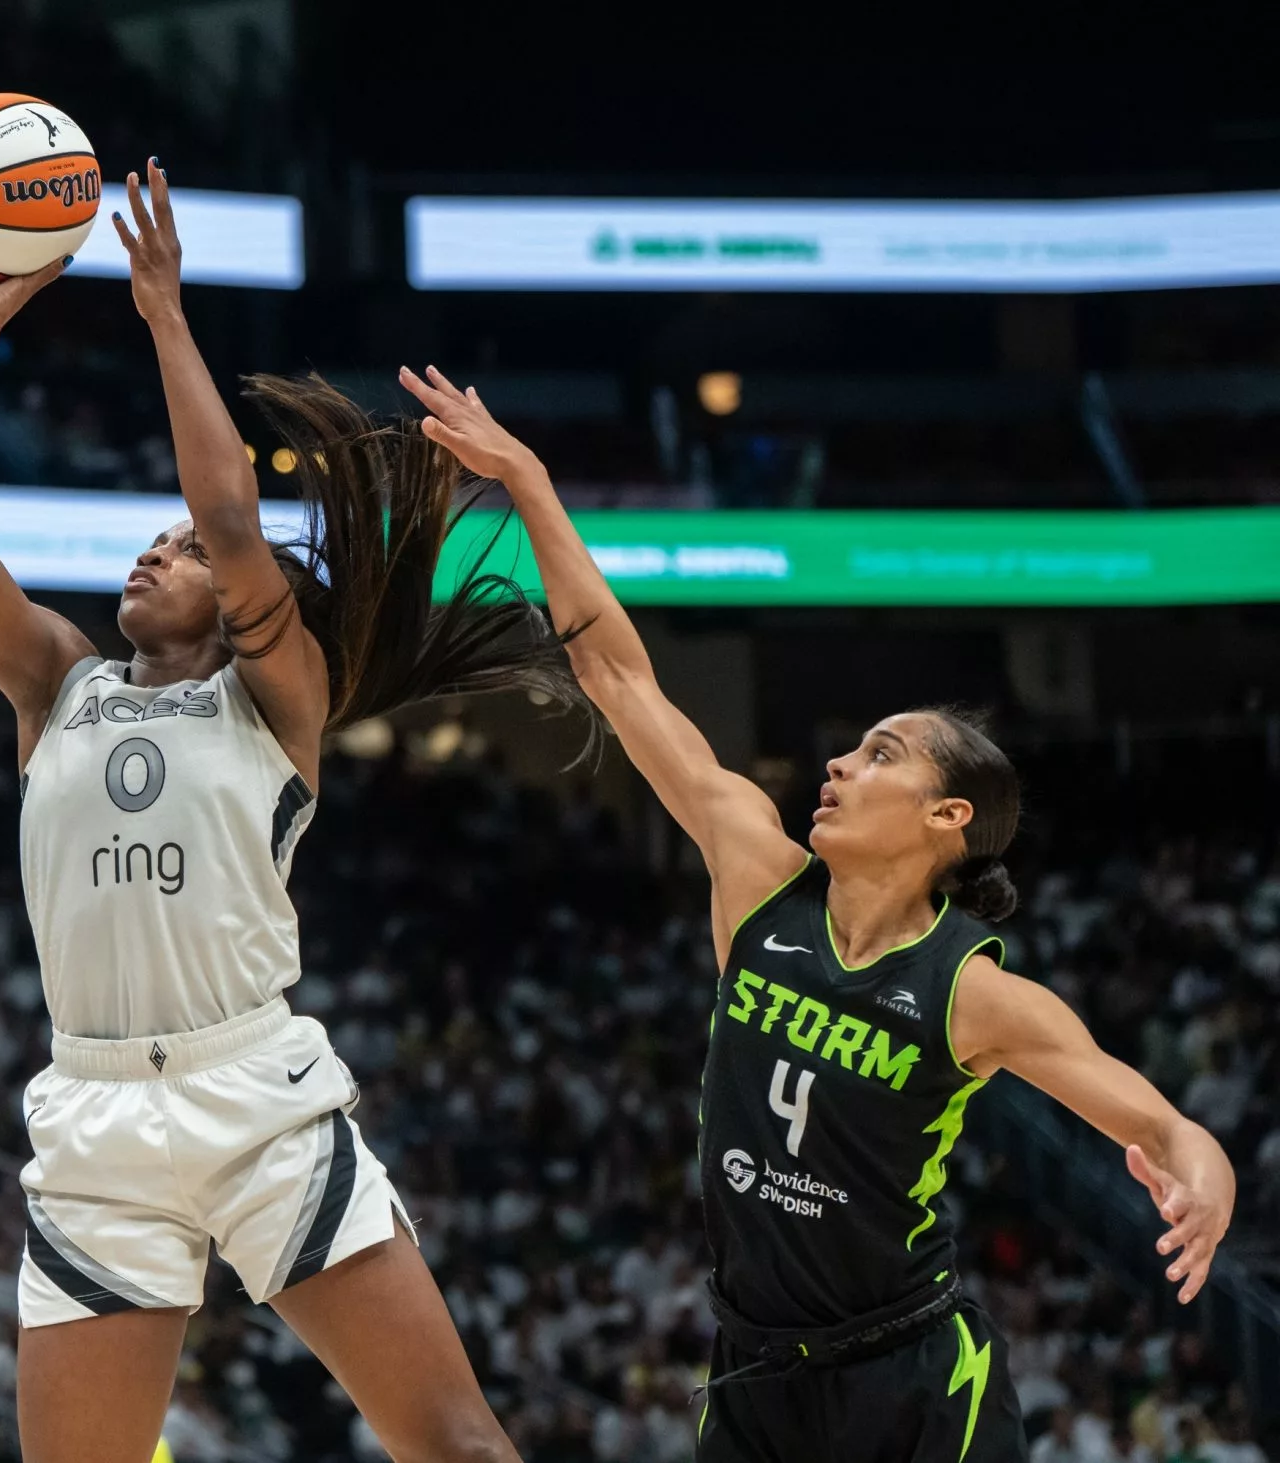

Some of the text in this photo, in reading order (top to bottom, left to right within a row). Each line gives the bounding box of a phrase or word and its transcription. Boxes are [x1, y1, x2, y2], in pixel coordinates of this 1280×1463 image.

[1, 168, 100, 208] Wilson
[64, 690, 219, 730] ACES
[105, 737, 167, 813] 0
[92, 834, 185, 895] ring
[726, 968, 922, 1092] STORM
[874, 995, 922, 1020] SYMETRA
[768, 1058, 817, 1159] 4
